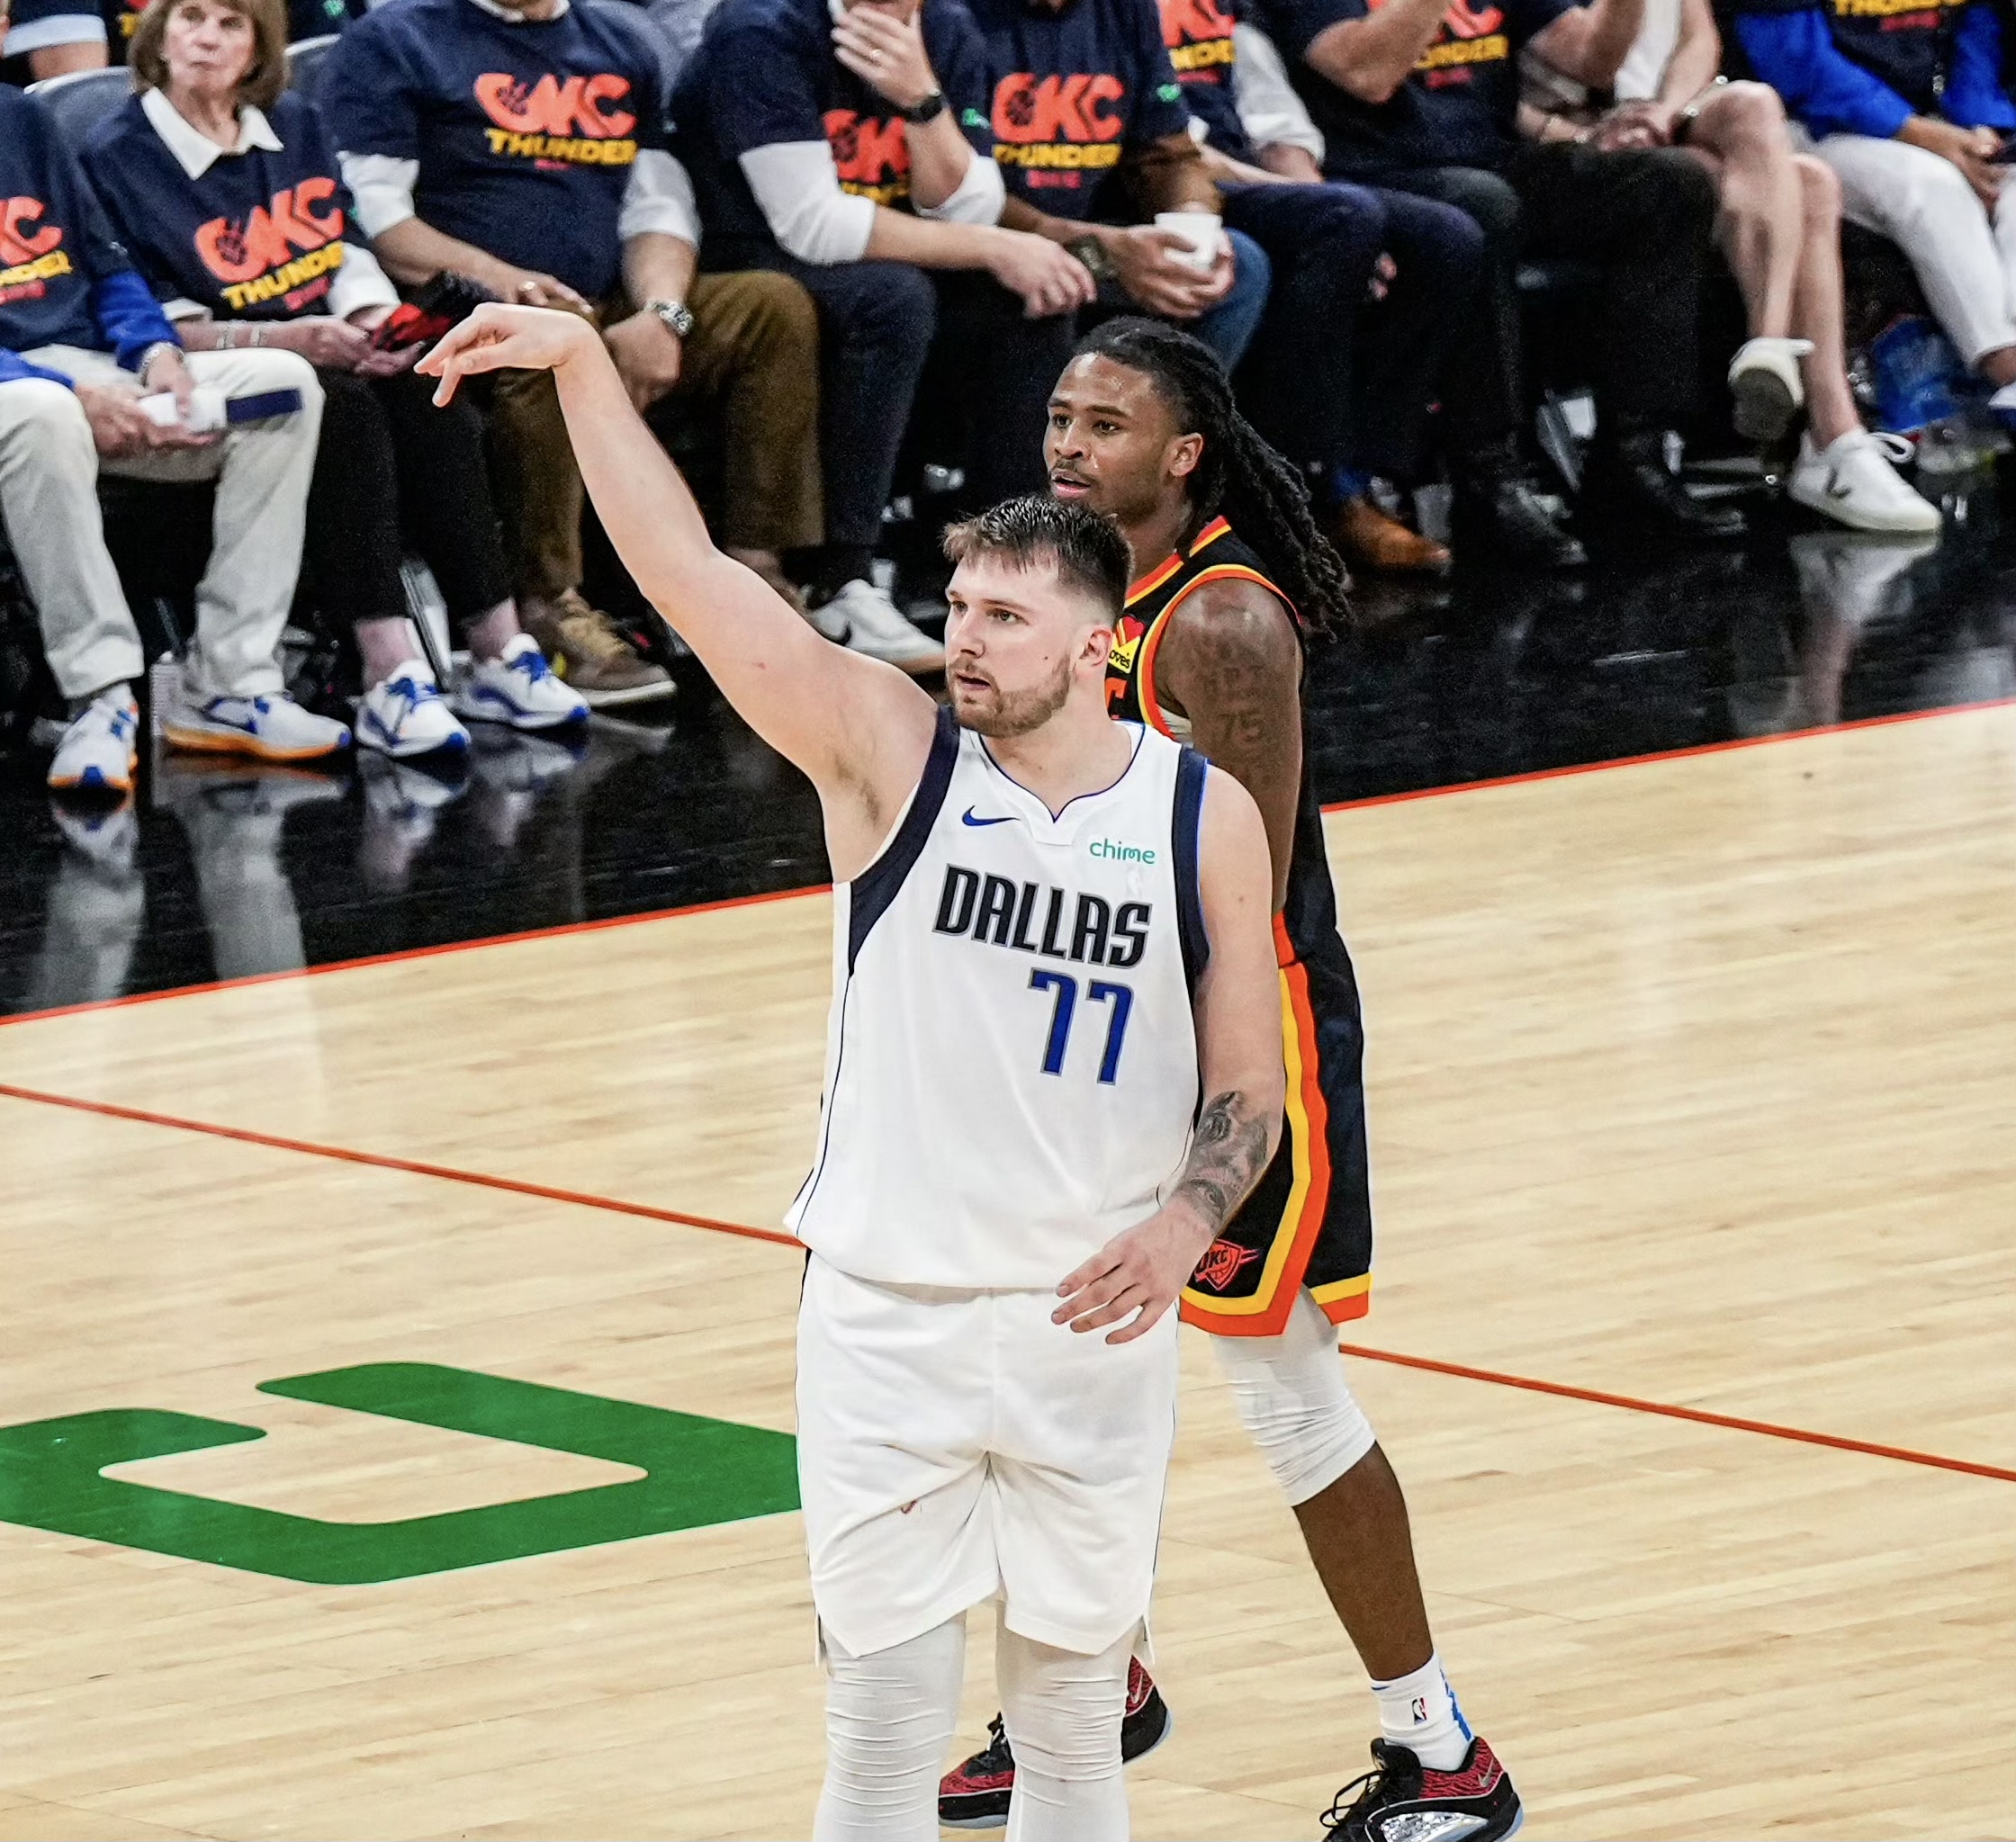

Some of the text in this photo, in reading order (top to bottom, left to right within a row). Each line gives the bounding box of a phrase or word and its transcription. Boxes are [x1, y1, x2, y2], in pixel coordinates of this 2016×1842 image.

[473, 72, 637, 139] OKC
[992, 72, 1124, 143] OKC
[485, 127, 638, 166] THUNDER
[823, 108, 911, 184] OK
[194, 177, 344, 283] OKC
[1089, 838, 1156, 865] chime
[932, 862, 1154, 970] DALLAS
[1027, 966, 1135, 1087] 77
